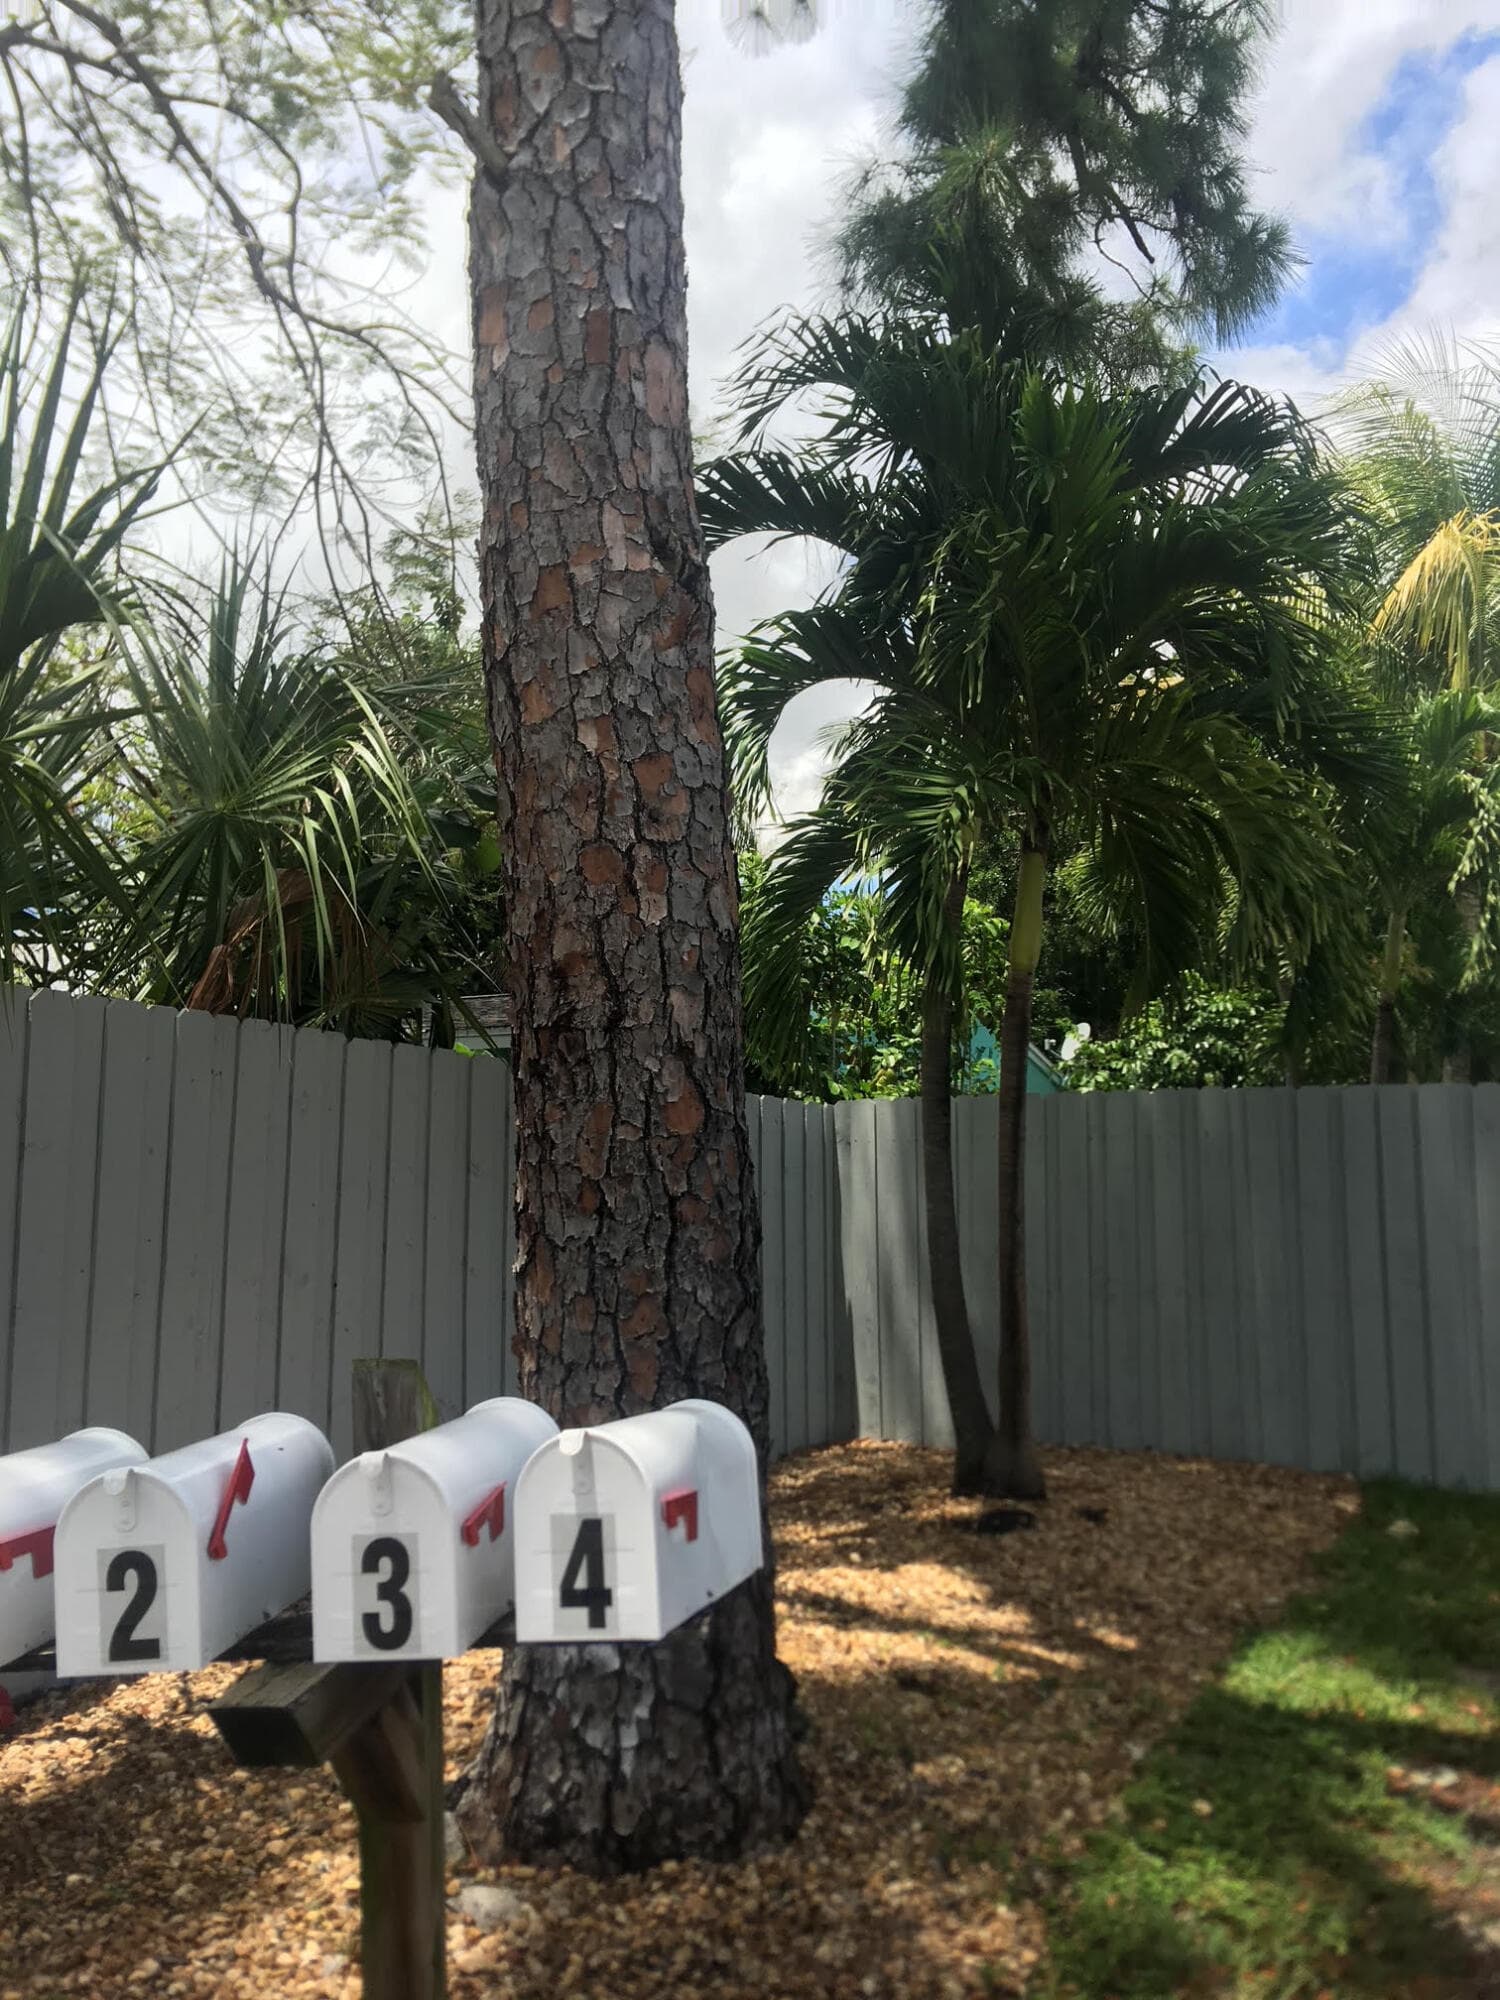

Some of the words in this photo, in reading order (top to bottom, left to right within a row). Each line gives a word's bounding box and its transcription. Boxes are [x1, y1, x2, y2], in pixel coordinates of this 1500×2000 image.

[106, 1550, 161, 1662] 2
[361, 1537, 413, 1651] 3
[560, 1519, 613, 1629] 4
